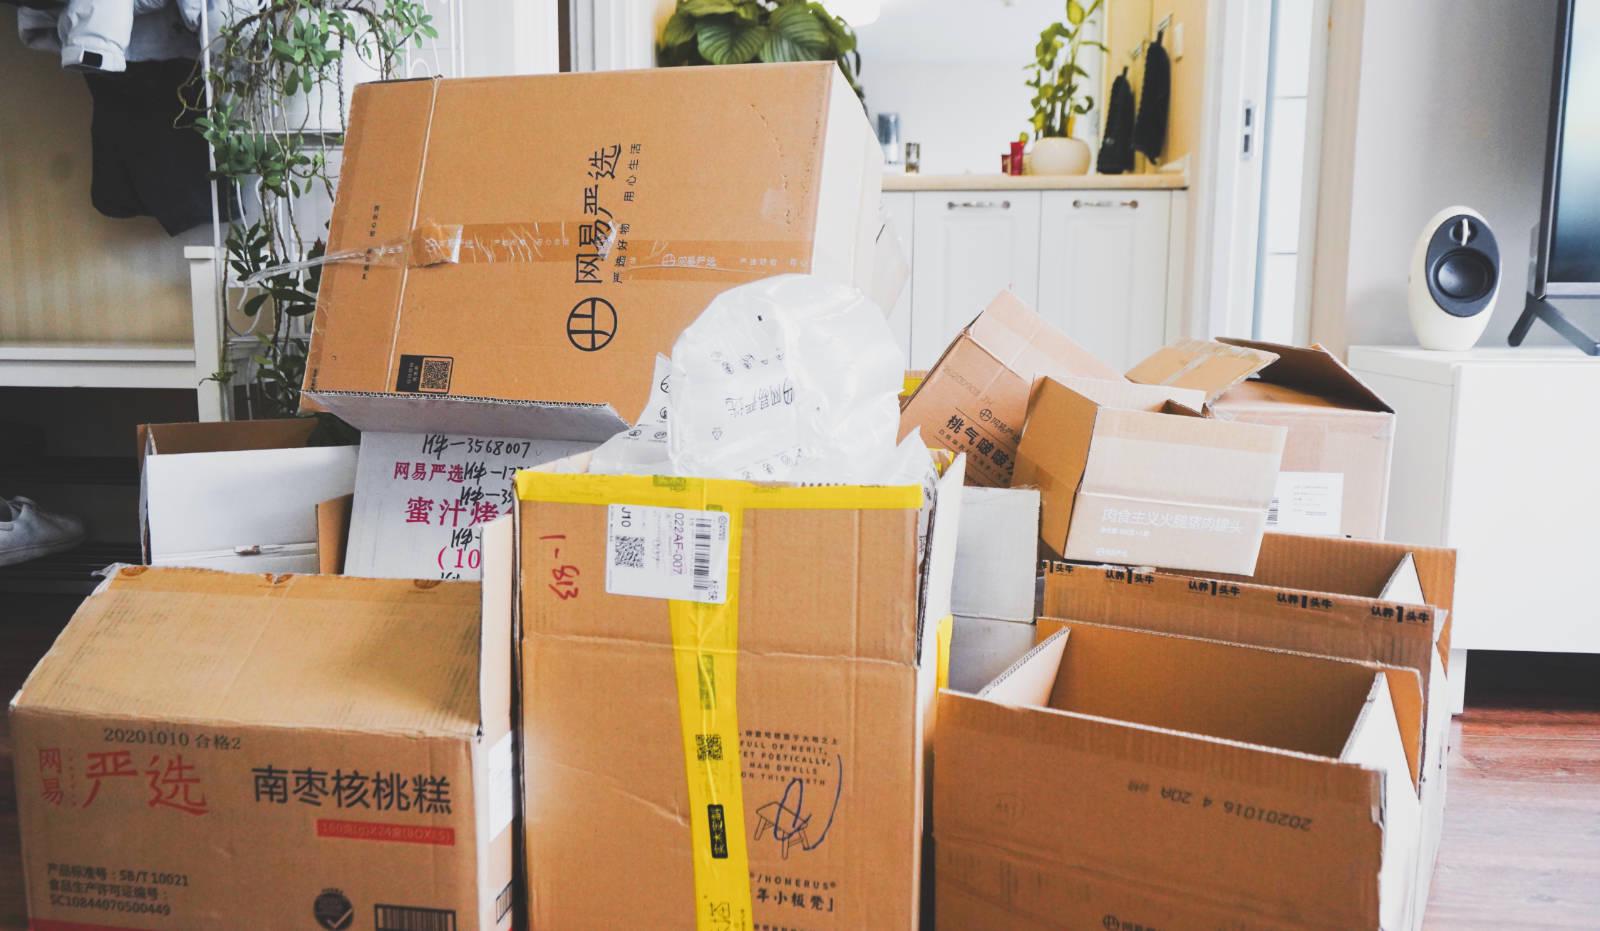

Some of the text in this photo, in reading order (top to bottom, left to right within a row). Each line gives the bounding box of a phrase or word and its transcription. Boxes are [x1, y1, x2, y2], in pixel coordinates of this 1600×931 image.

[574, 144, 622, 285] 网易严选
[612, 142, 643, 284] 严选好物 用心生活
[393, 461, 465, 483] 网易严选
[405, 496, 513, 527] 蜜汁烤
[619, 506, 632, 528] J10
[672, 512, 685, 576] 022AF-007
[103, 727, 241, 750] 20201010 合格2
[771, 742, 785, 751] OF
[38, 747, 64, 806] 网易
[82, 750, 210, 817] 严选
[776, 763, 818, 776] DWELLS
[251, 764, 453, 815] 南枣核桃糕
[1223, 800, 1313, 831] 20201016
